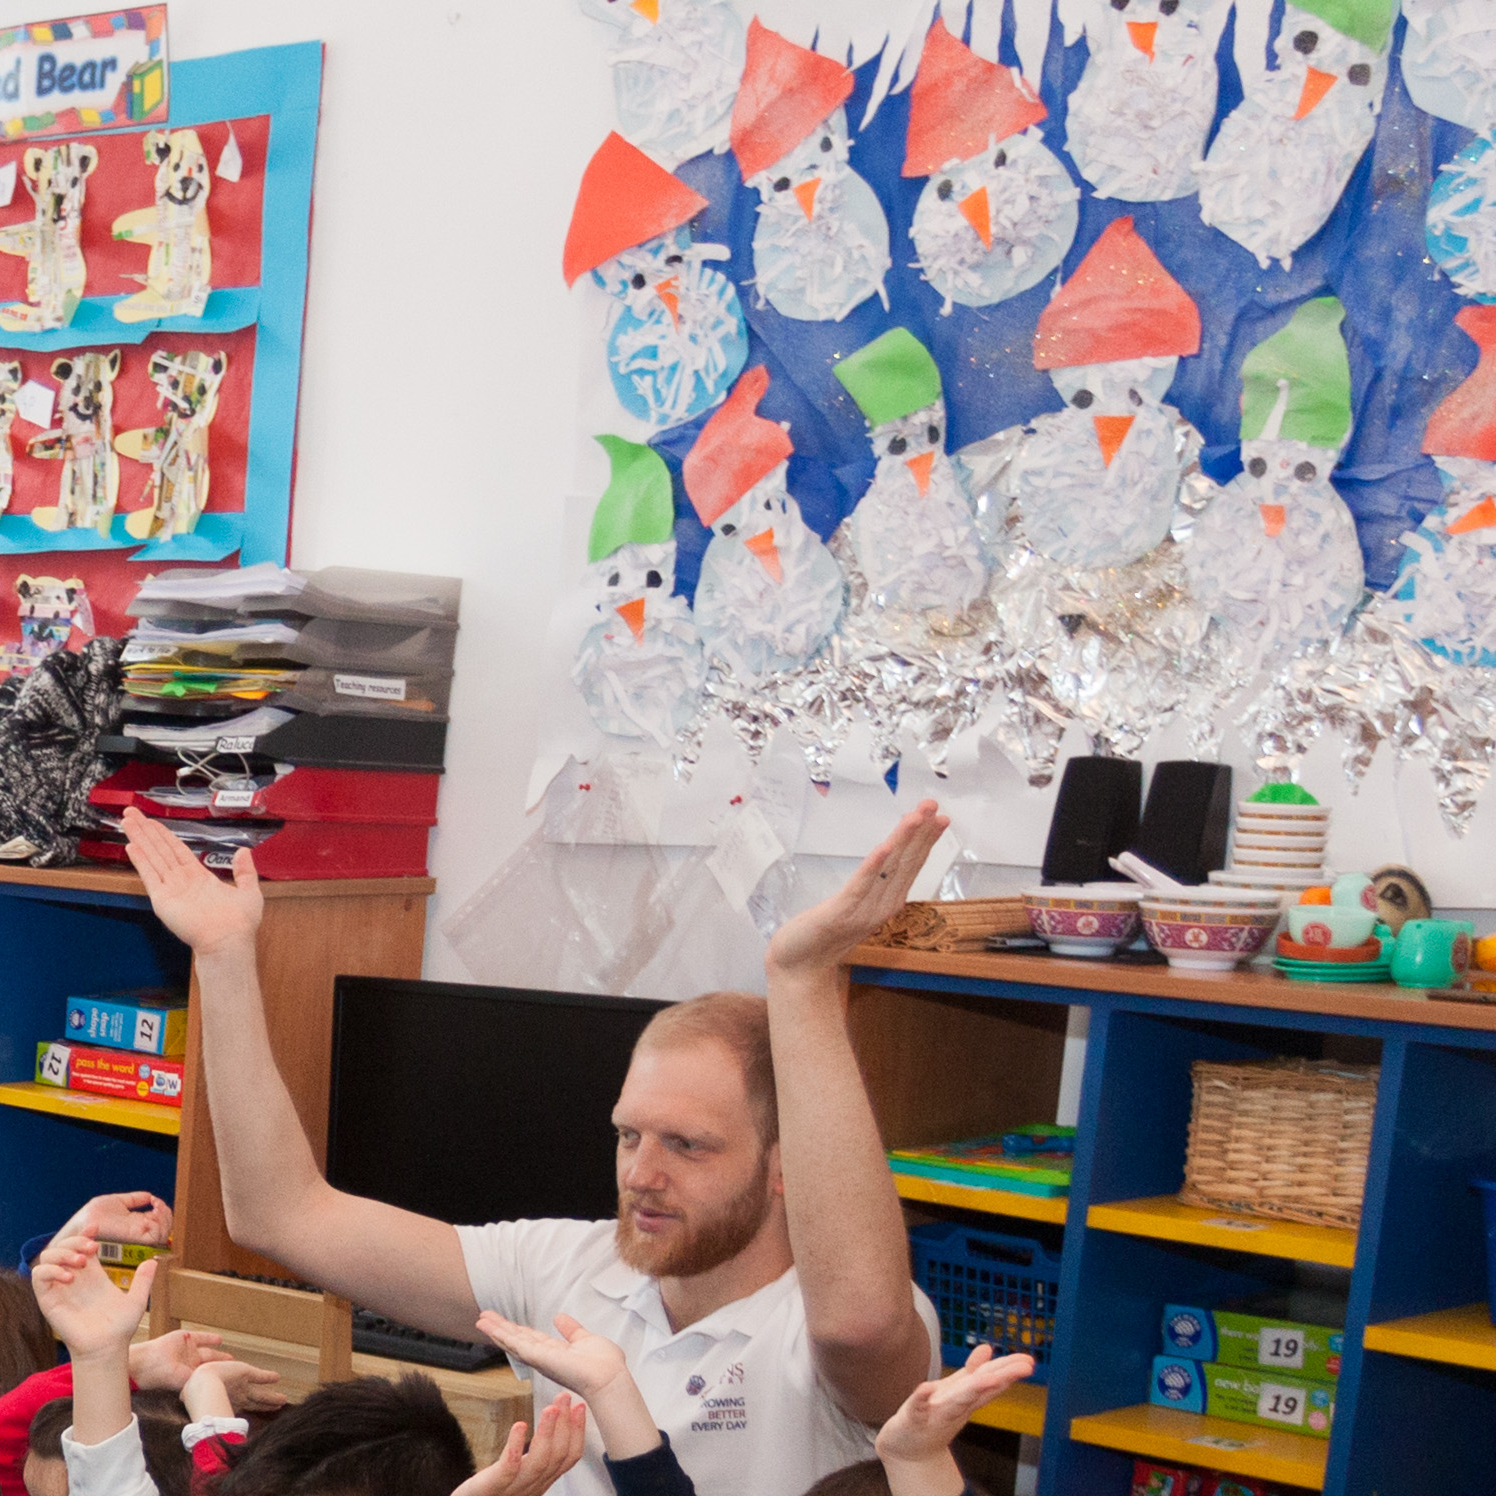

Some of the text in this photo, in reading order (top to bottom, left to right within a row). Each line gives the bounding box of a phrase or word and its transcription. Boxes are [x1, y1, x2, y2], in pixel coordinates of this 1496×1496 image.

[35, 51, 118, 98] Bear
[335, 678, 402, 695] Teaching resources
[219, 793, 251, 801] Armand
[88, 1007, 99, 1038] shape
[99, 1012, 109, 1038] snap
[140, 1018, 154, 1042] 12
[47, 1052, 62, 1076] 12
[75, 1058, 135, 1075] pass the word
[1269, 1338, 1299, 1358] 19
[1215, 1378, 1241, 1390] new
[708, 1409, 746, 1419] BETTER
[1268, 1394, 1298, 1416] 19
[691, 1421, 747, 1431] EVERY DAY
